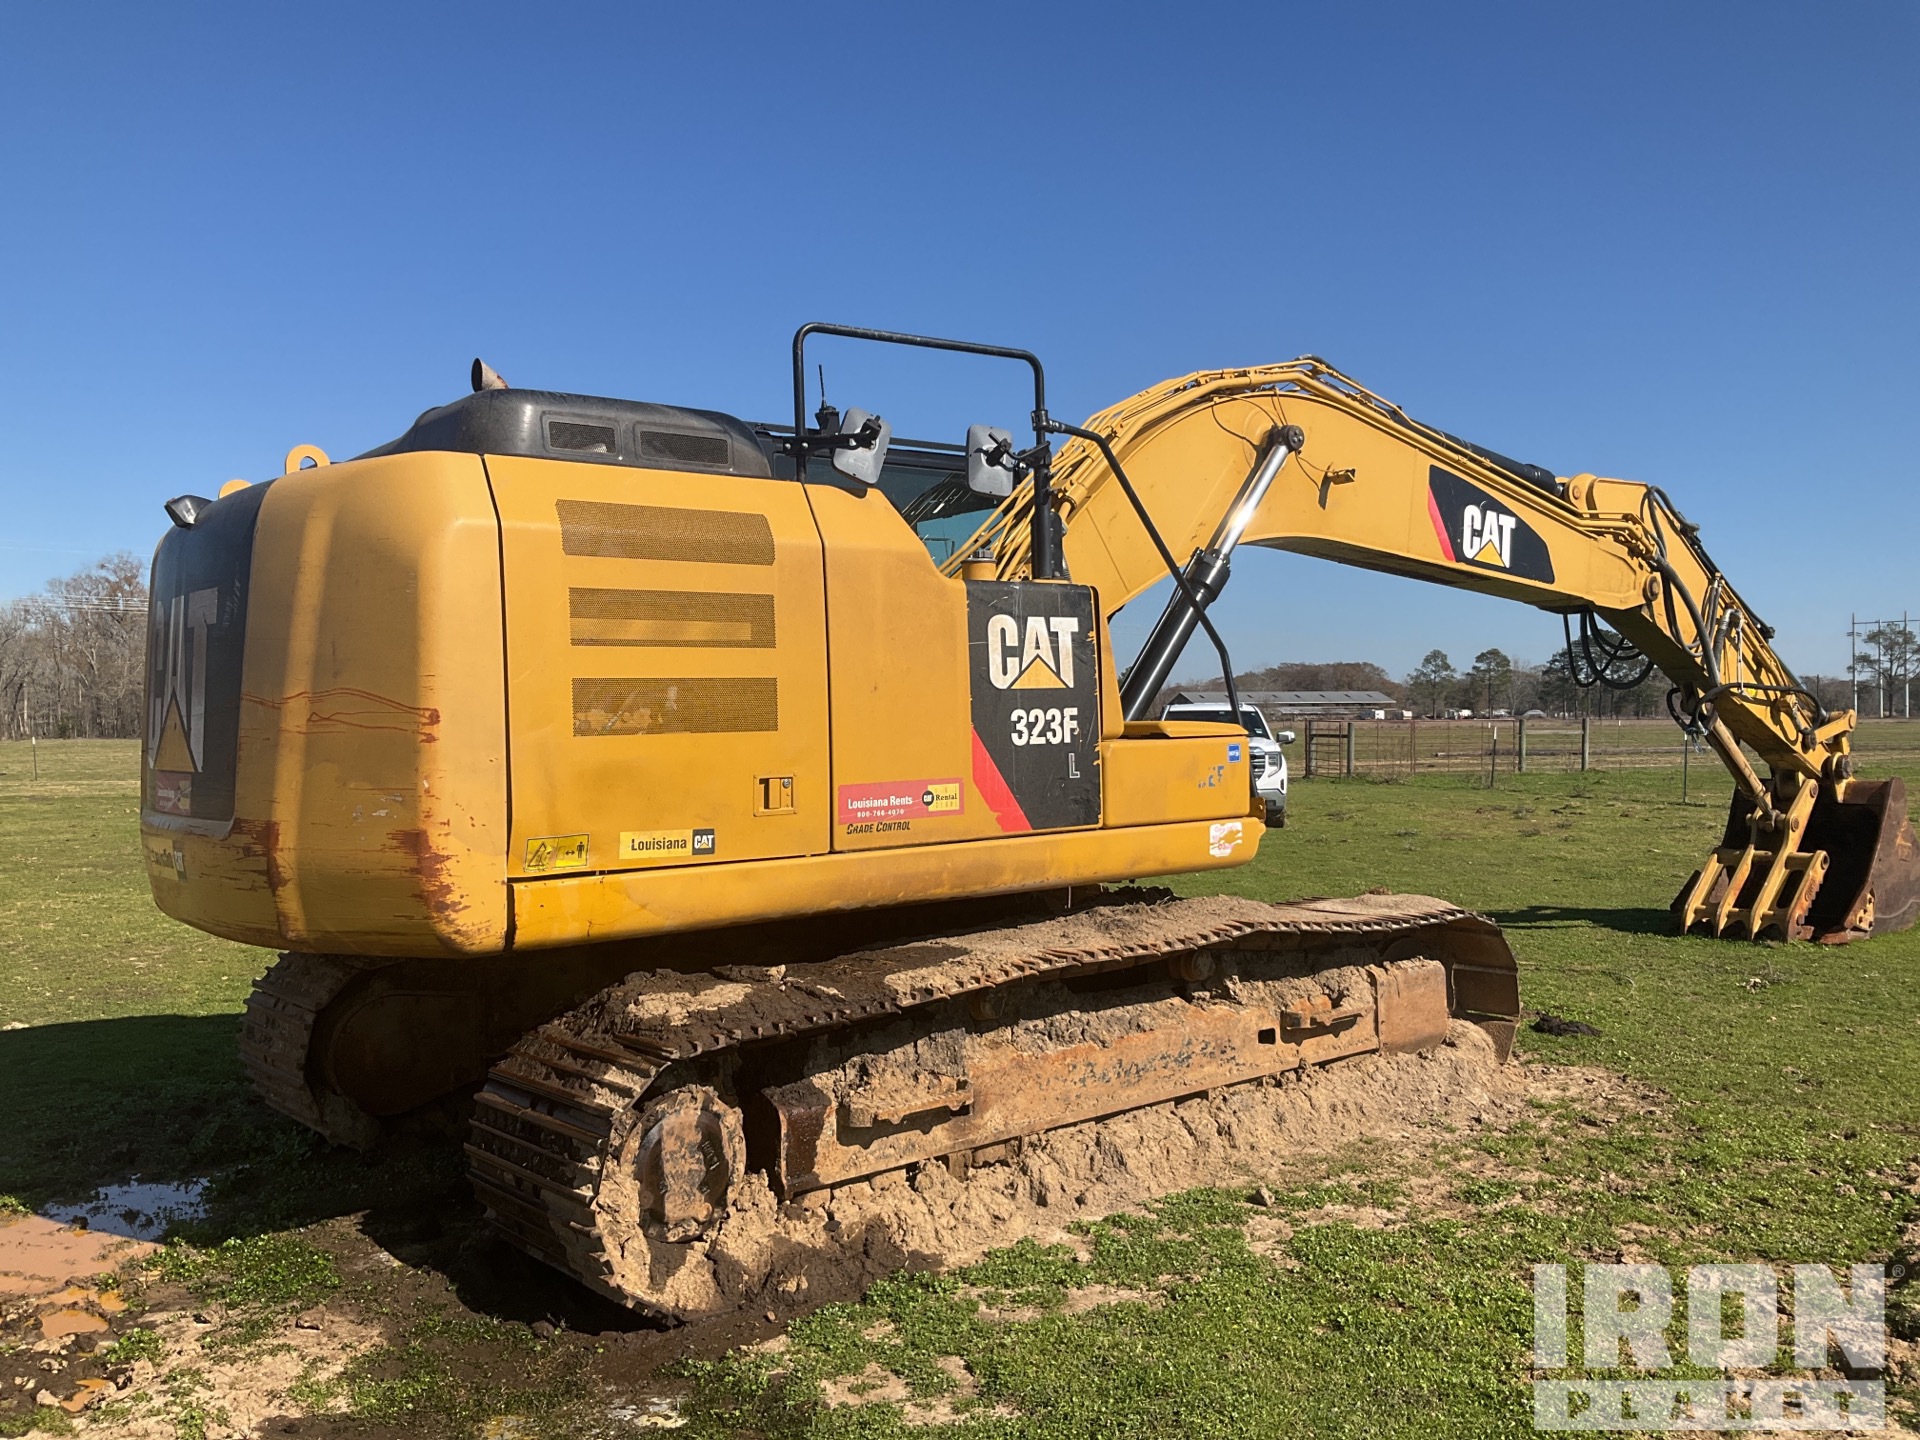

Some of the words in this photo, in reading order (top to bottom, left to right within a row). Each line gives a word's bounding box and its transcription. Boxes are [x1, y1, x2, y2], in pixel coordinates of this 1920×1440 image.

[1463, 505, 1516, 568] CAT
[988, 615, 1079, 689] CAT
[148, 587, 218, 772] CAT
[1011, 708, 1078, 746] 323F
[1069, 753, 1081, 778] L
[848, 797, 889, 809] Louisiana
[890, 795, 913, 807] Rents
[935, 793, 958, 801] Rental
[846, 823, 874, 835] GRADE
[876, 821, 911, 832] CONTROL
[631, 838, 687, 851] Louisiana
[694, 834, 714, 849] CAT
